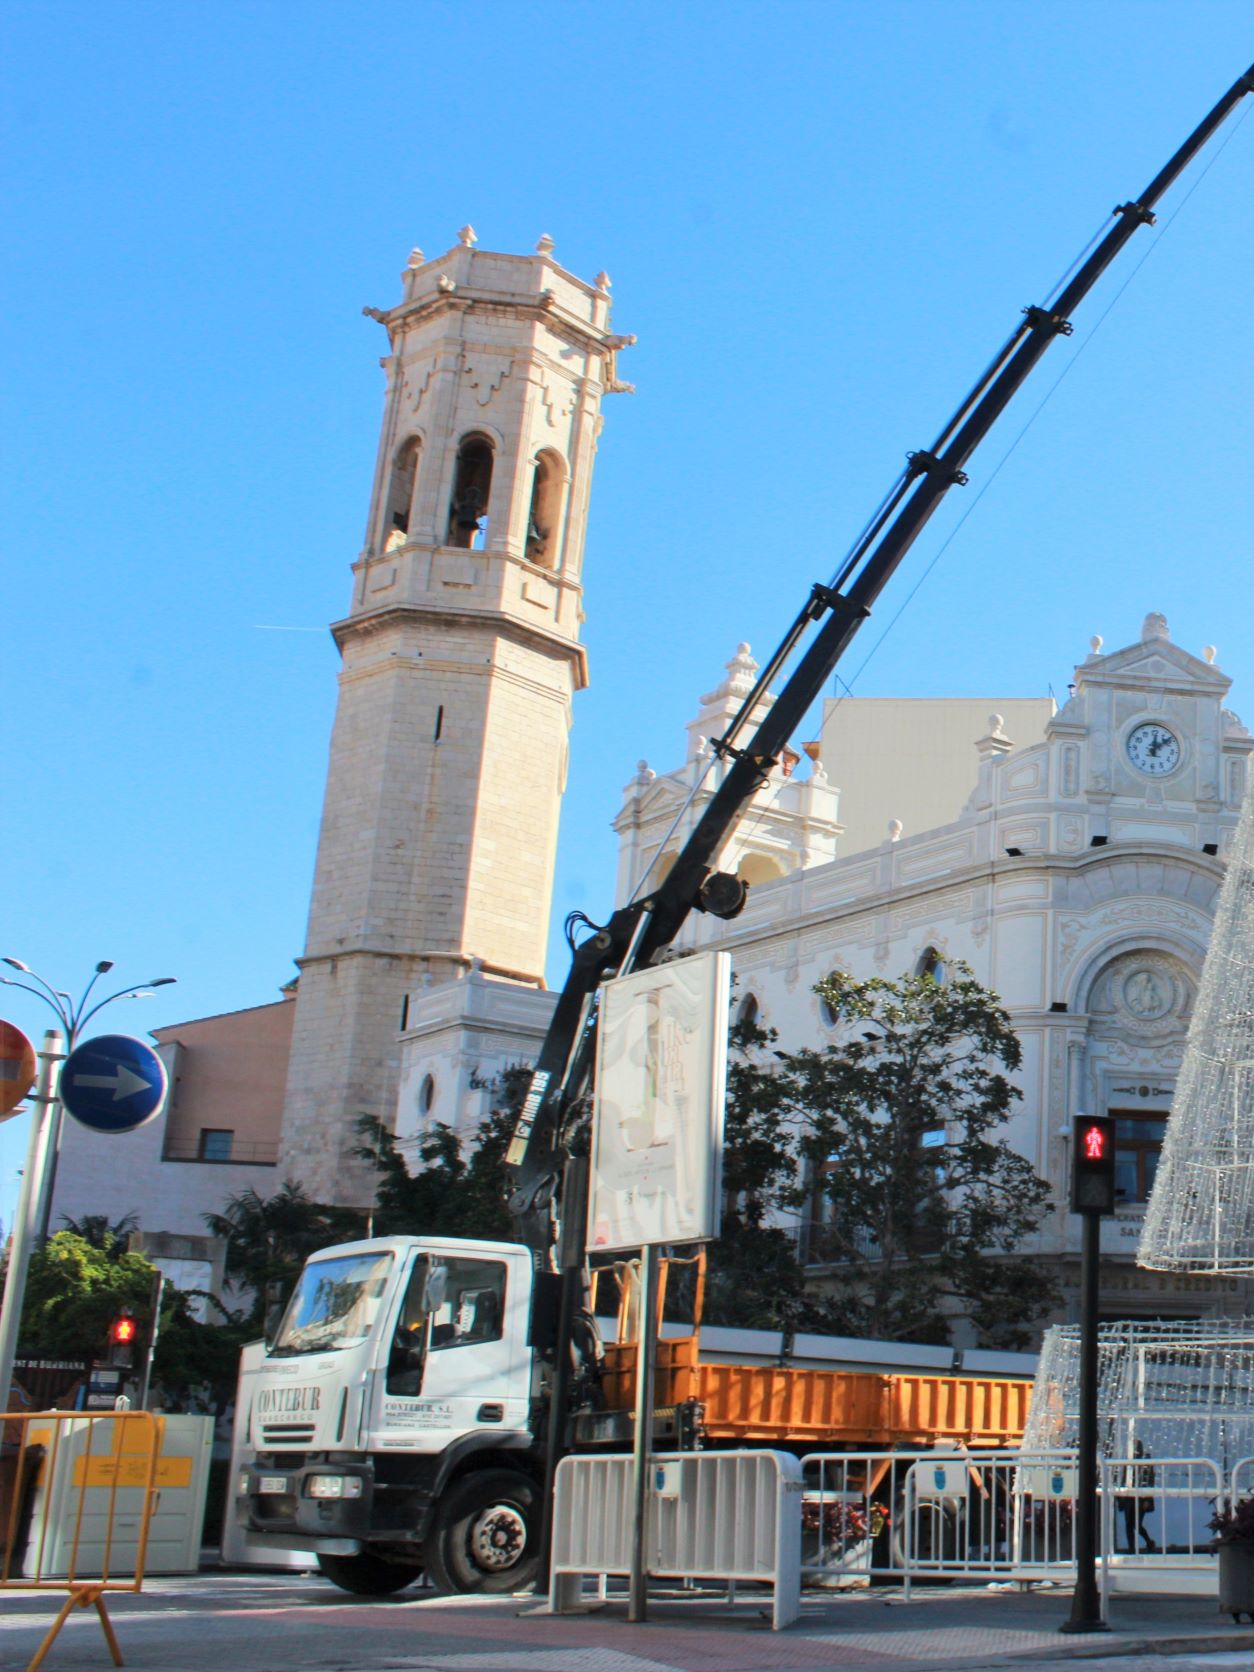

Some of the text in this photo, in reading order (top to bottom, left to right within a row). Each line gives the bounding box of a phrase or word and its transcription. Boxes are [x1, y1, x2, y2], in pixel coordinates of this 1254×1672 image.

[520, 1071, 549, 1121] HIAB 195
[259, 1386, 320, 1413] CONTEBUR
